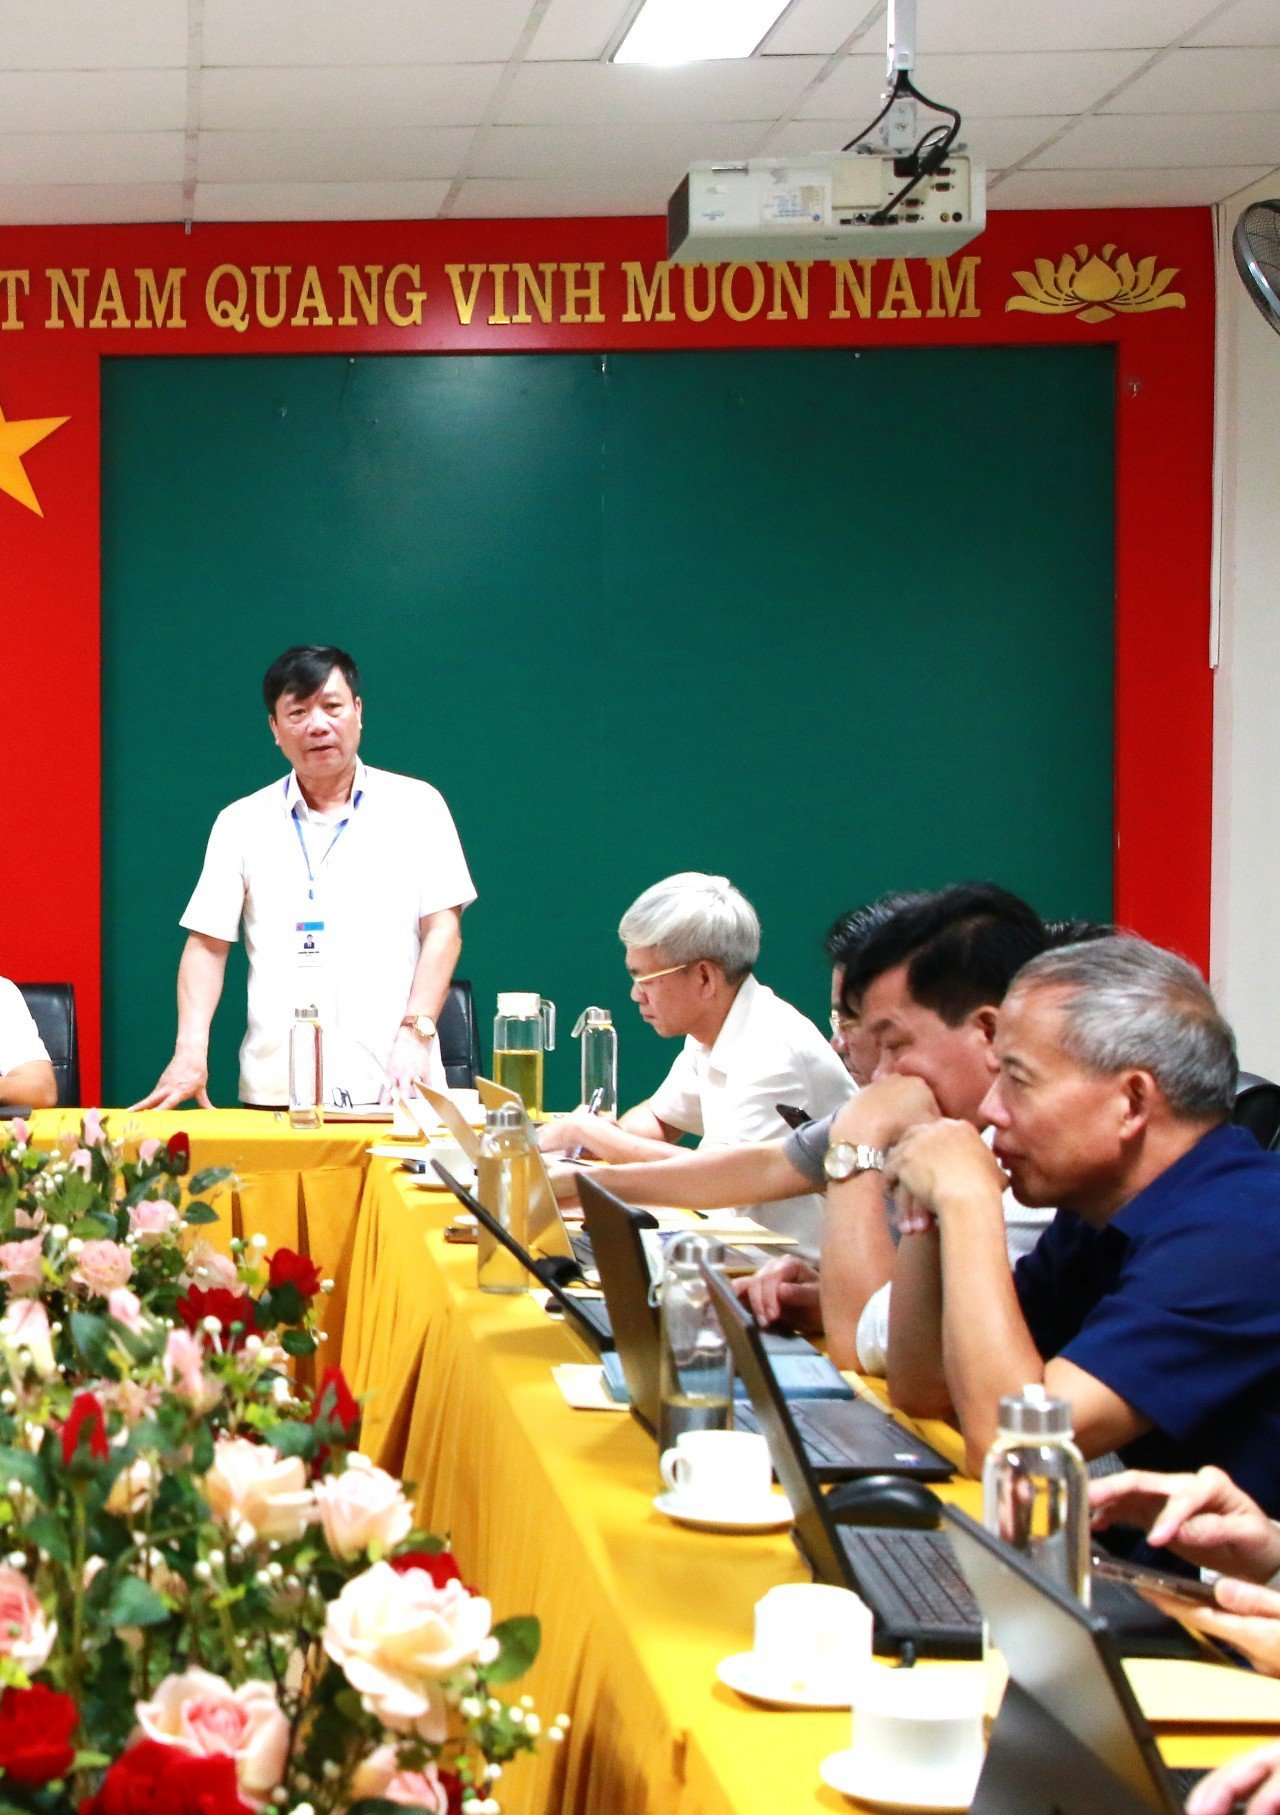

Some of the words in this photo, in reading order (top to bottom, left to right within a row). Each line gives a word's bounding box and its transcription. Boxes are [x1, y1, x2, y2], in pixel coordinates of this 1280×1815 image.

[45, 268, 187, 329] NAM
[205, 264, 427, 333] QUANG
[445, 262, 606, 325] VINH
